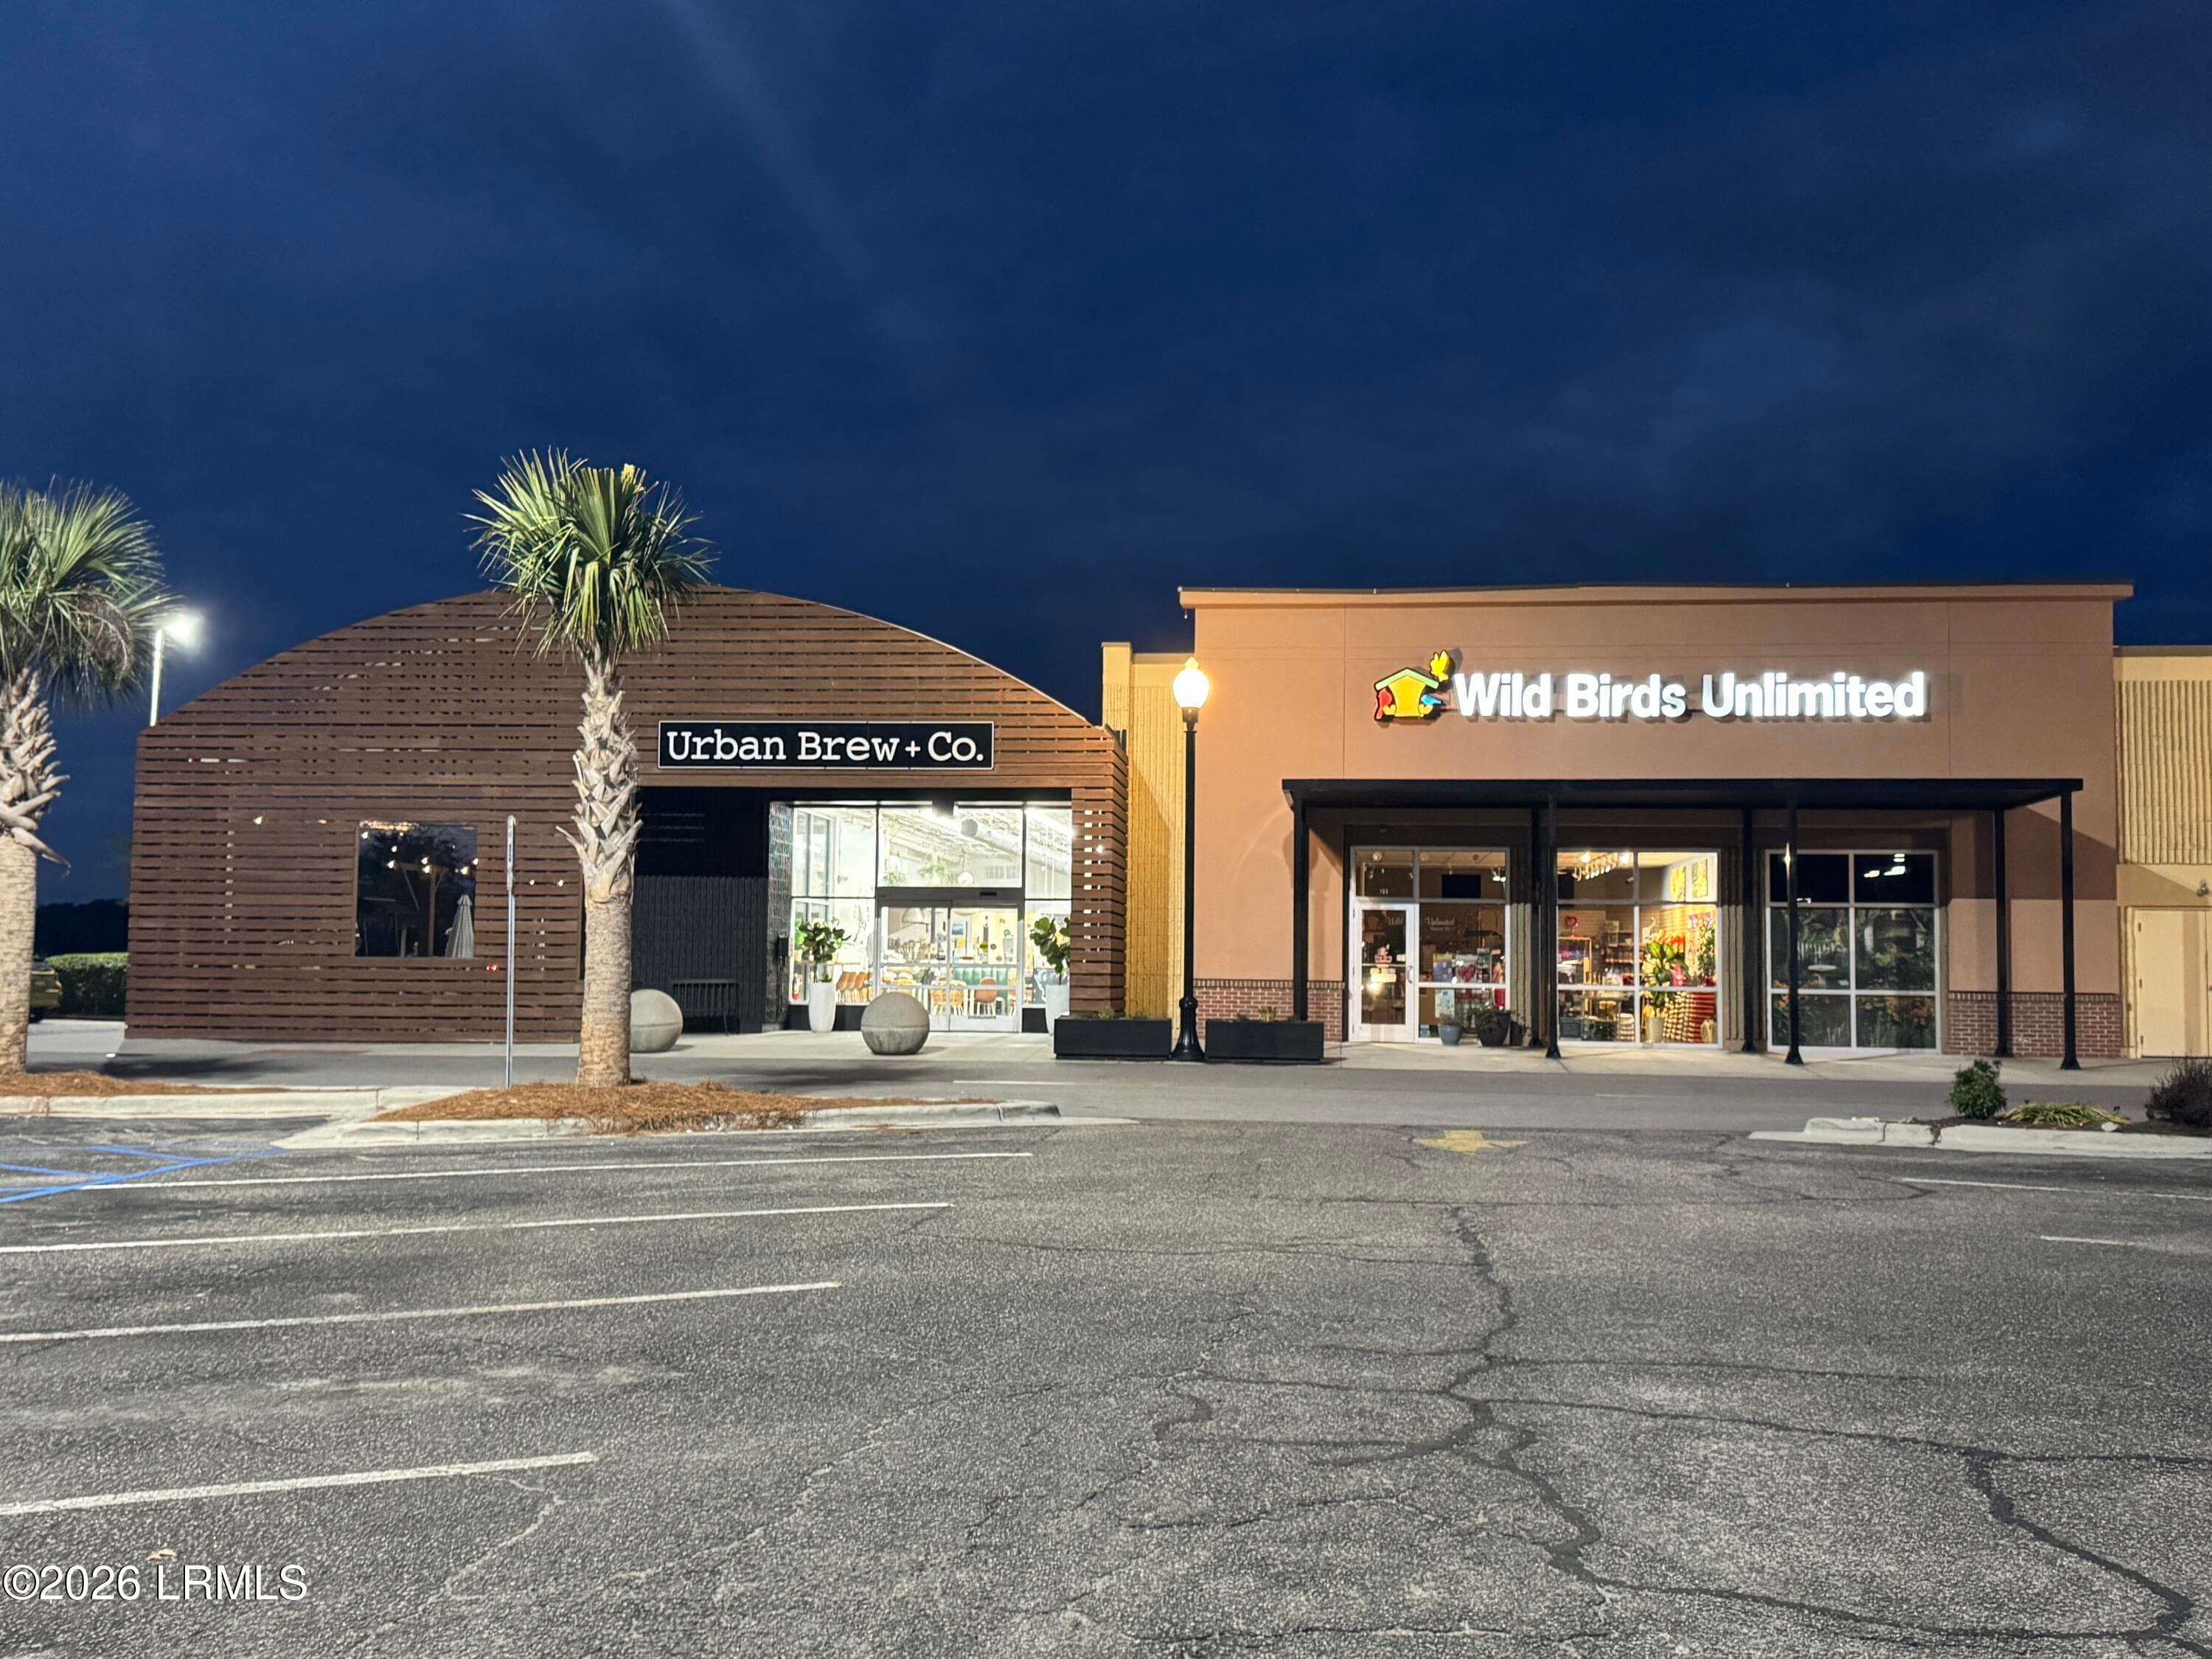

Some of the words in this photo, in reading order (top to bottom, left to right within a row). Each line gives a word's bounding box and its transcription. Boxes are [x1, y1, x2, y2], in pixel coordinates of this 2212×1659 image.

[1453, 672, 1551, 717] Wild
[1566, 673, 1686, 717] Birds
[1702, 671, 1924, 717] Unlimited
[667, 728, 787, 761] Urban
[797, 731, 900, 762] Brew
[928, 731, 984, 762] Co.
